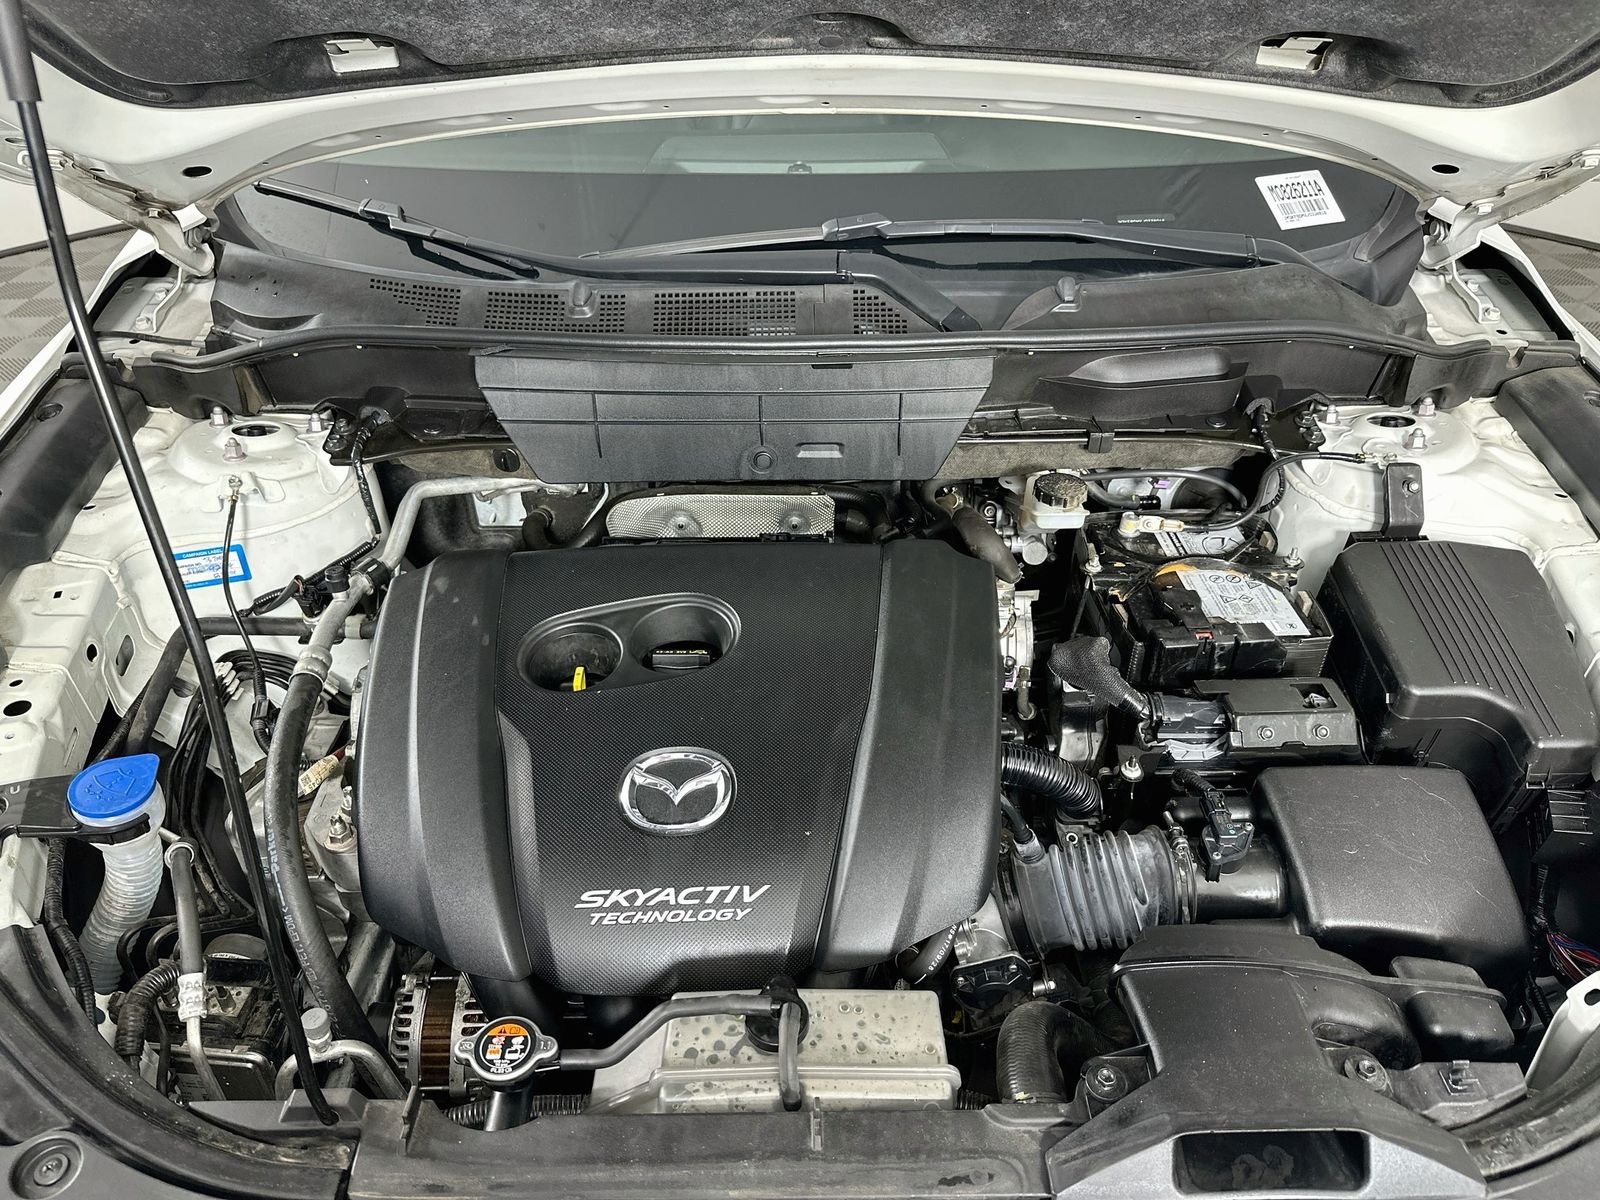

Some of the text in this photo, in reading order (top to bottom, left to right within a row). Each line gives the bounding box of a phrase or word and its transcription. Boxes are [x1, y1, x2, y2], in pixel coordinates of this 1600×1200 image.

[267, 828, 280, 873] Parker
[574, 884, 771, 909] SKYACTIV
[590, 908, 752, 925] TECHNOLOGY
